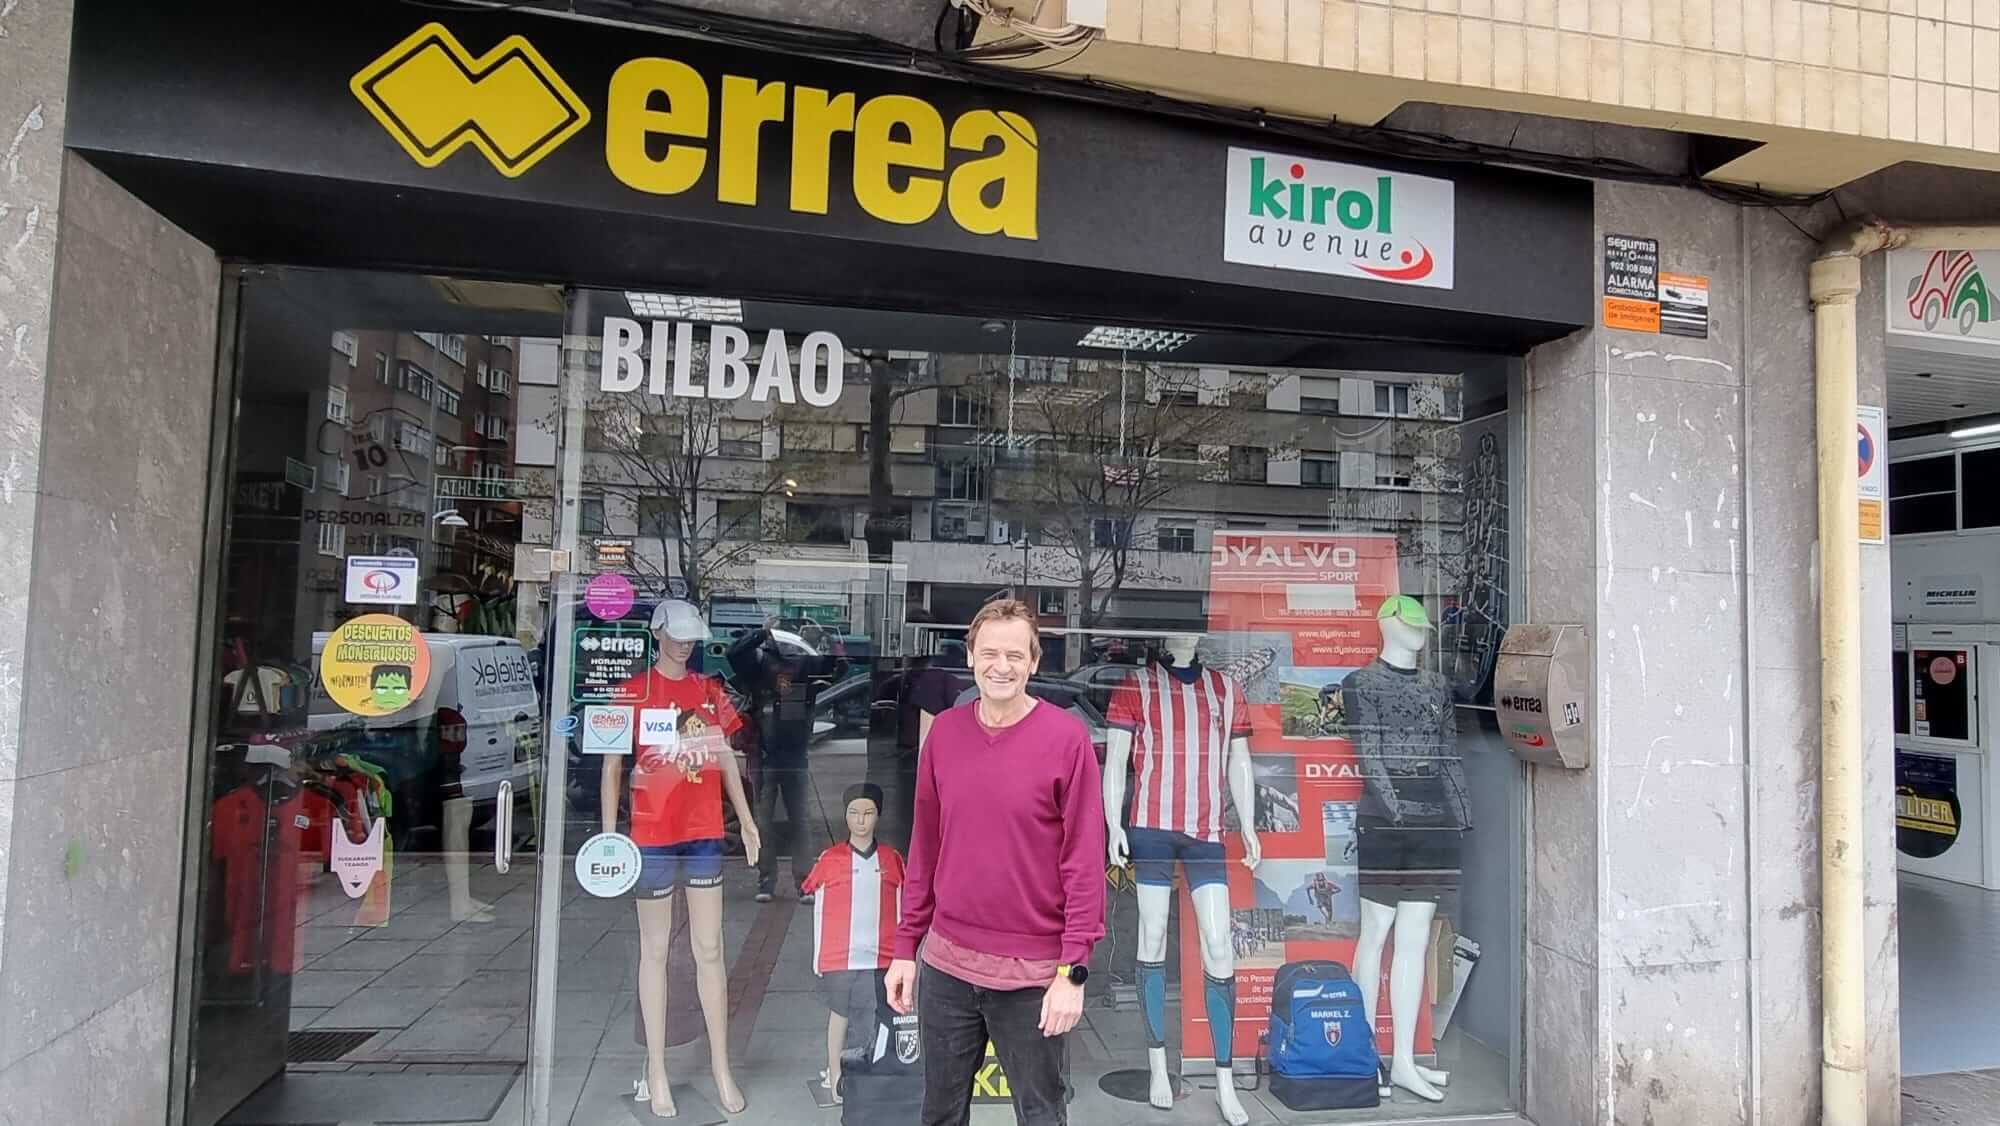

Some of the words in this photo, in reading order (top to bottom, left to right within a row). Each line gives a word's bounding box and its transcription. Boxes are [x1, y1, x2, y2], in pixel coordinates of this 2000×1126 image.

[1248, 156, 1393, 234] kirol
[1249, 223, 1393, 261] avenue
[1607, 236, 1656, 253] segurma
[1607, 274, 1656, 292] ALARMA
[600, 316, 845, 408] BILBAO
[440, 479, 505, 498] ATHLETIC
[304, 509, 426, 527] PERSONALIZA
[1319, 571, 1359, 582] SPORT
[1926, 589, 1977, 598] MICHELIN
[343, 623, 413, 641] DESCUENTOS
[336, 644, 417, 662] MONSTRUOSOS
[600, 636, 645, 652] errea
[590, 658, 633, 666] HORARIO
[1513, 695, 1543, 713] errea
[644, 721, 673, 732] VISA
[590, 862, 626, 878] Eup!
